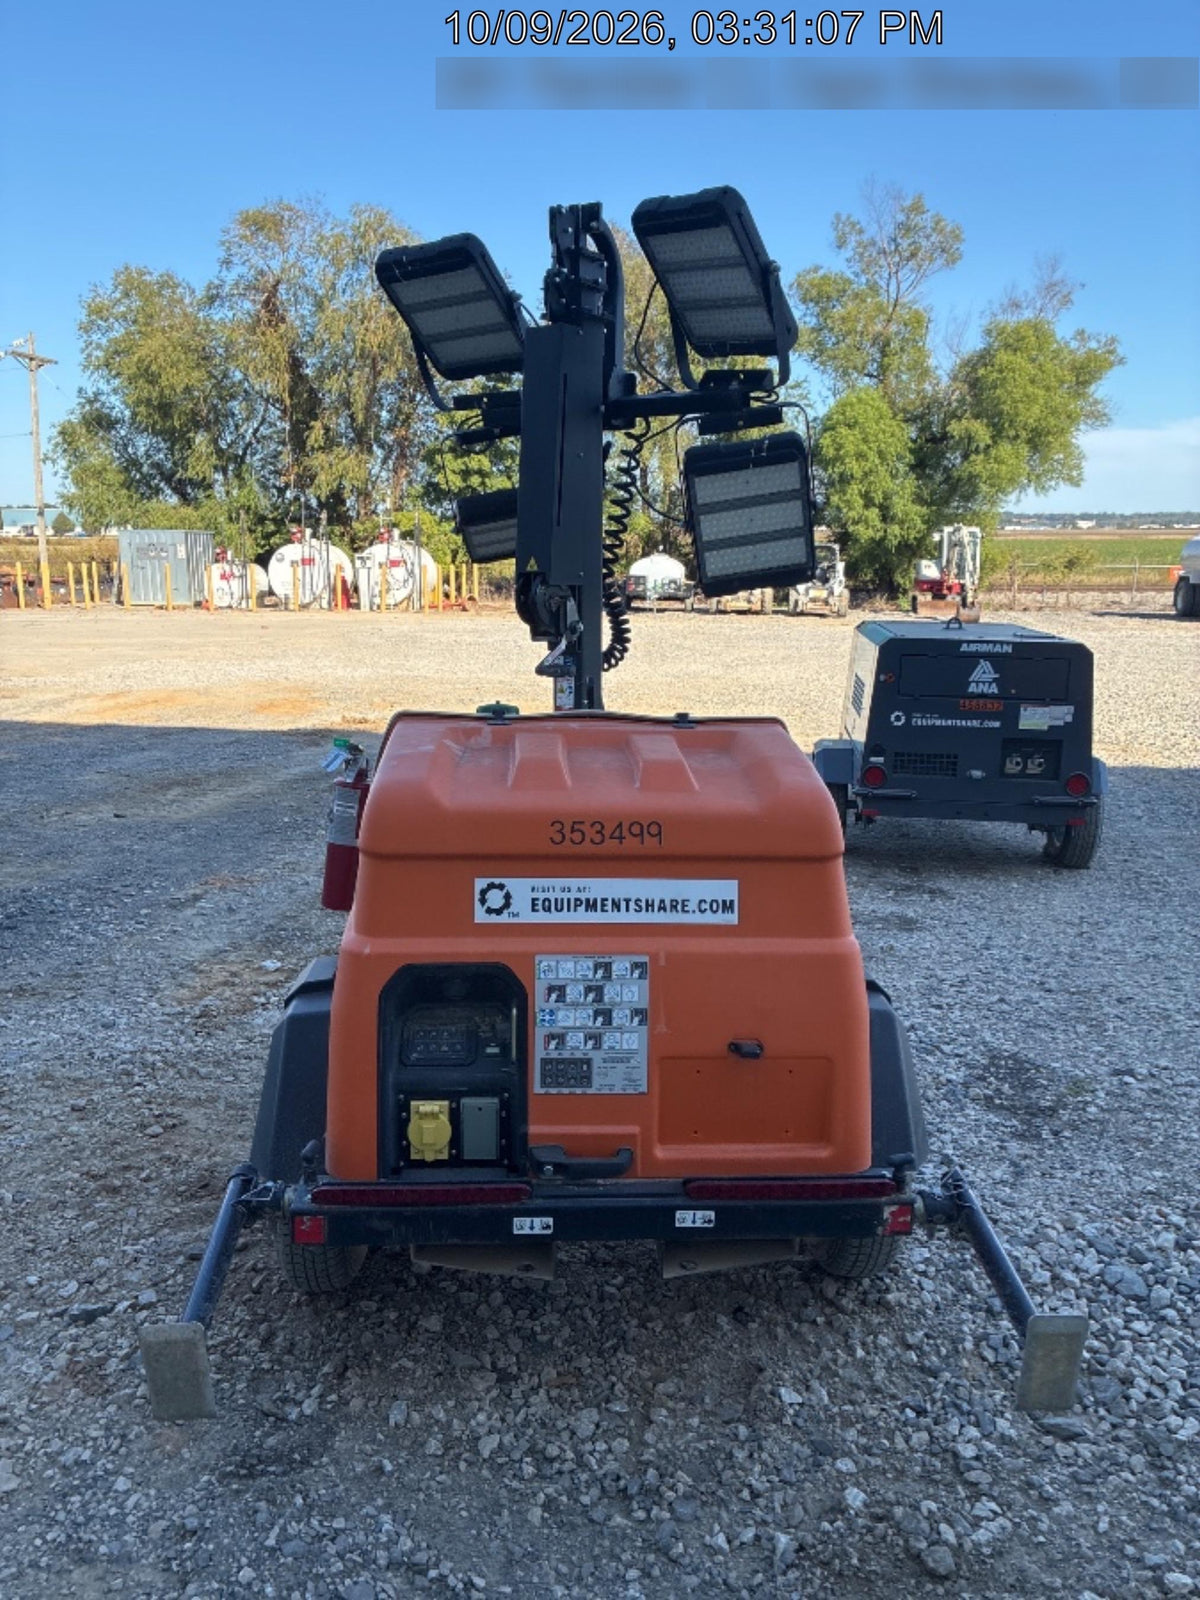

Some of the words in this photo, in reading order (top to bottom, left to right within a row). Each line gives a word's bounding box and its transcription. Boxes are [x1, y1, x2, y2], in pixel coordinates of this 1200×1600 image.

[960, 642, 1013, 653] AIRMAN
[968, 682, 999, 694] ANA
[549, 820, 663, 846] 353499
[531, 896, 735, 914] EQUIPMENTSHARE.COM
